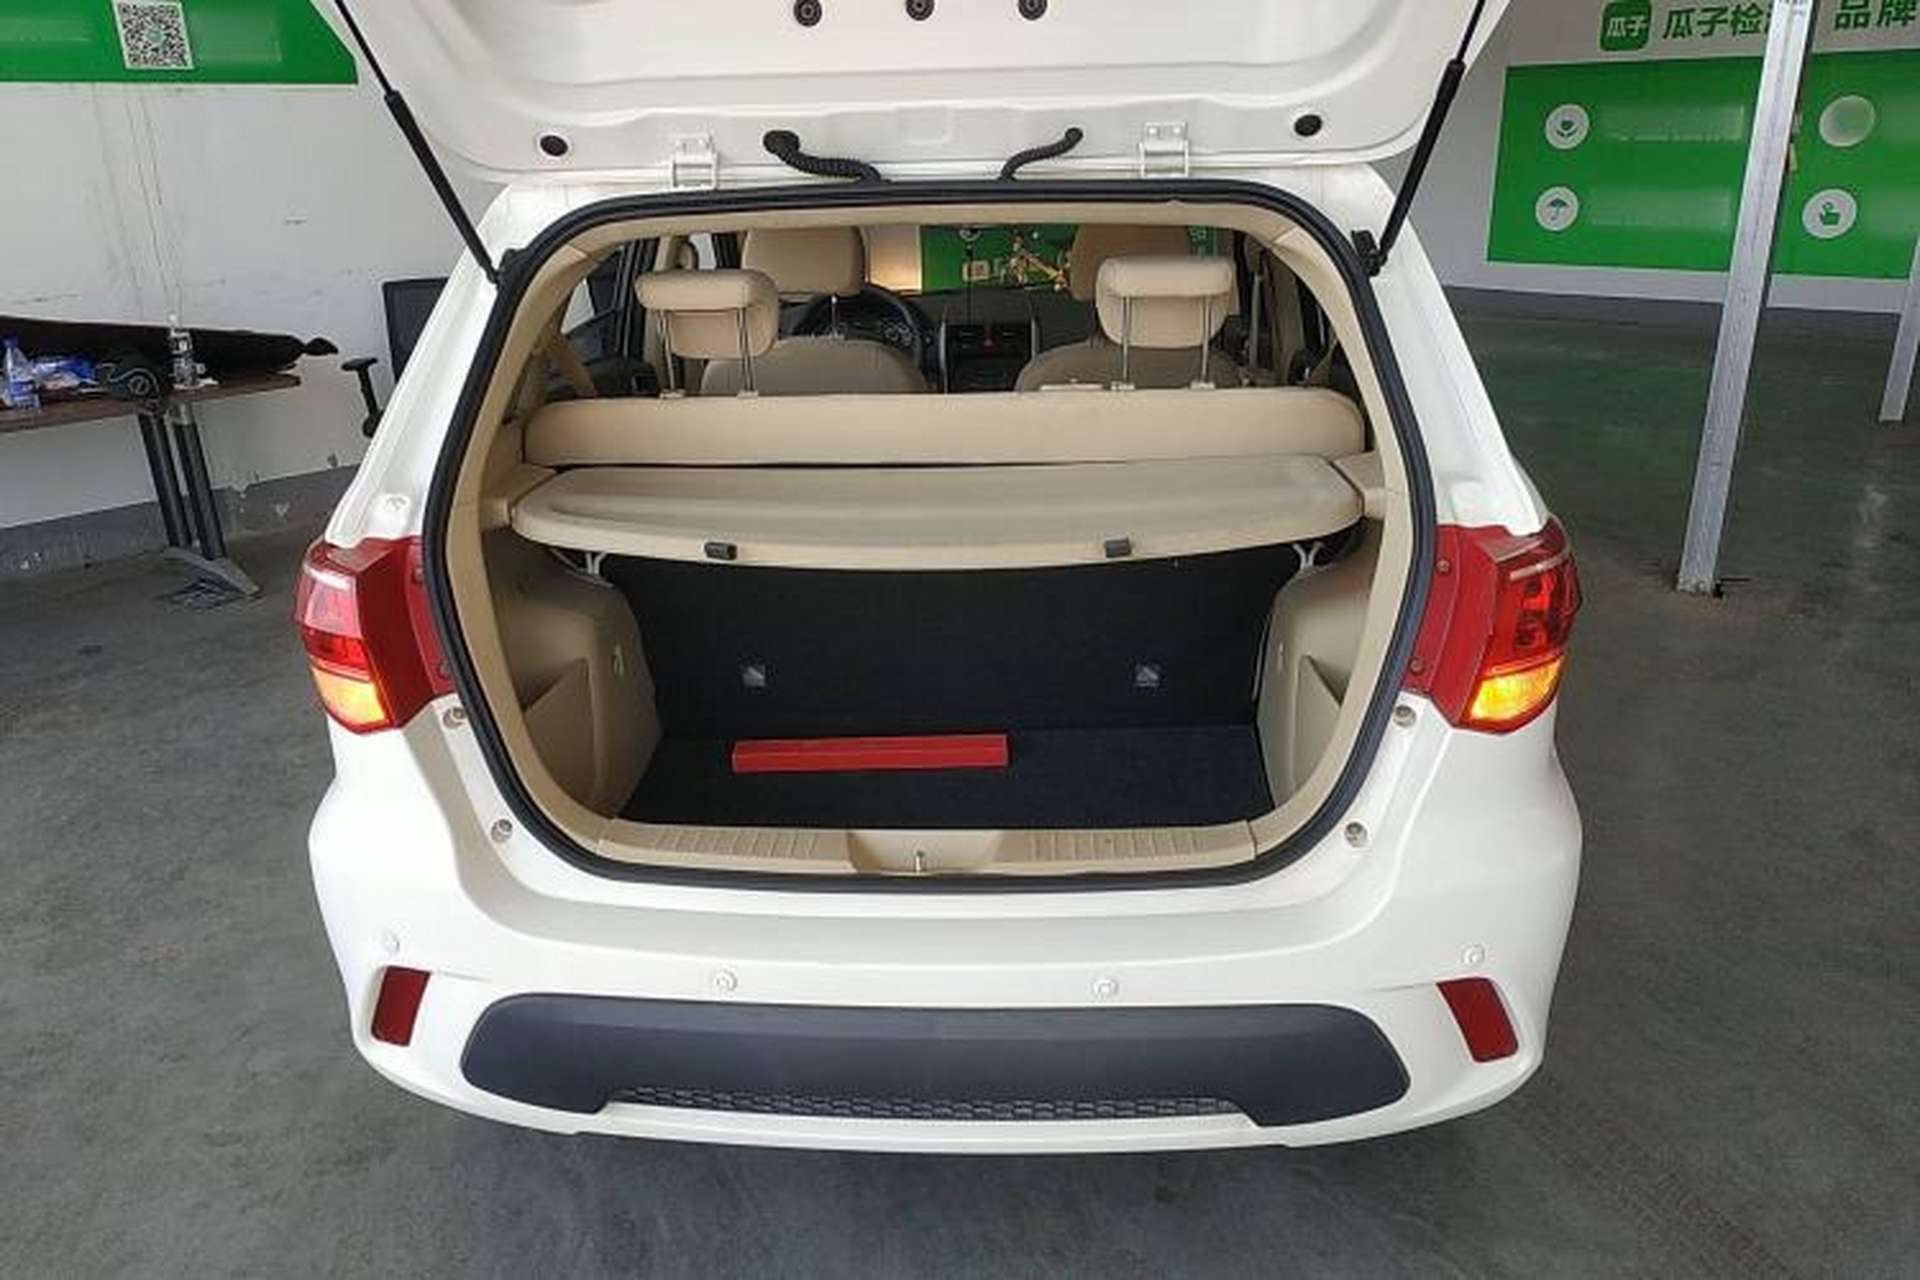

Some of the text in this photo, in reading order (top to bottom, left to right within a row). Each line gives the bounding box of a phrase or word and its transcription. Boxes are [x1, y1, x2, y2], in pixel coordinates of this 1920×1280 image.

[1606, 14, 1648, 37] 瓜子
[1662, 3, 1772, 39] 瓜子检
